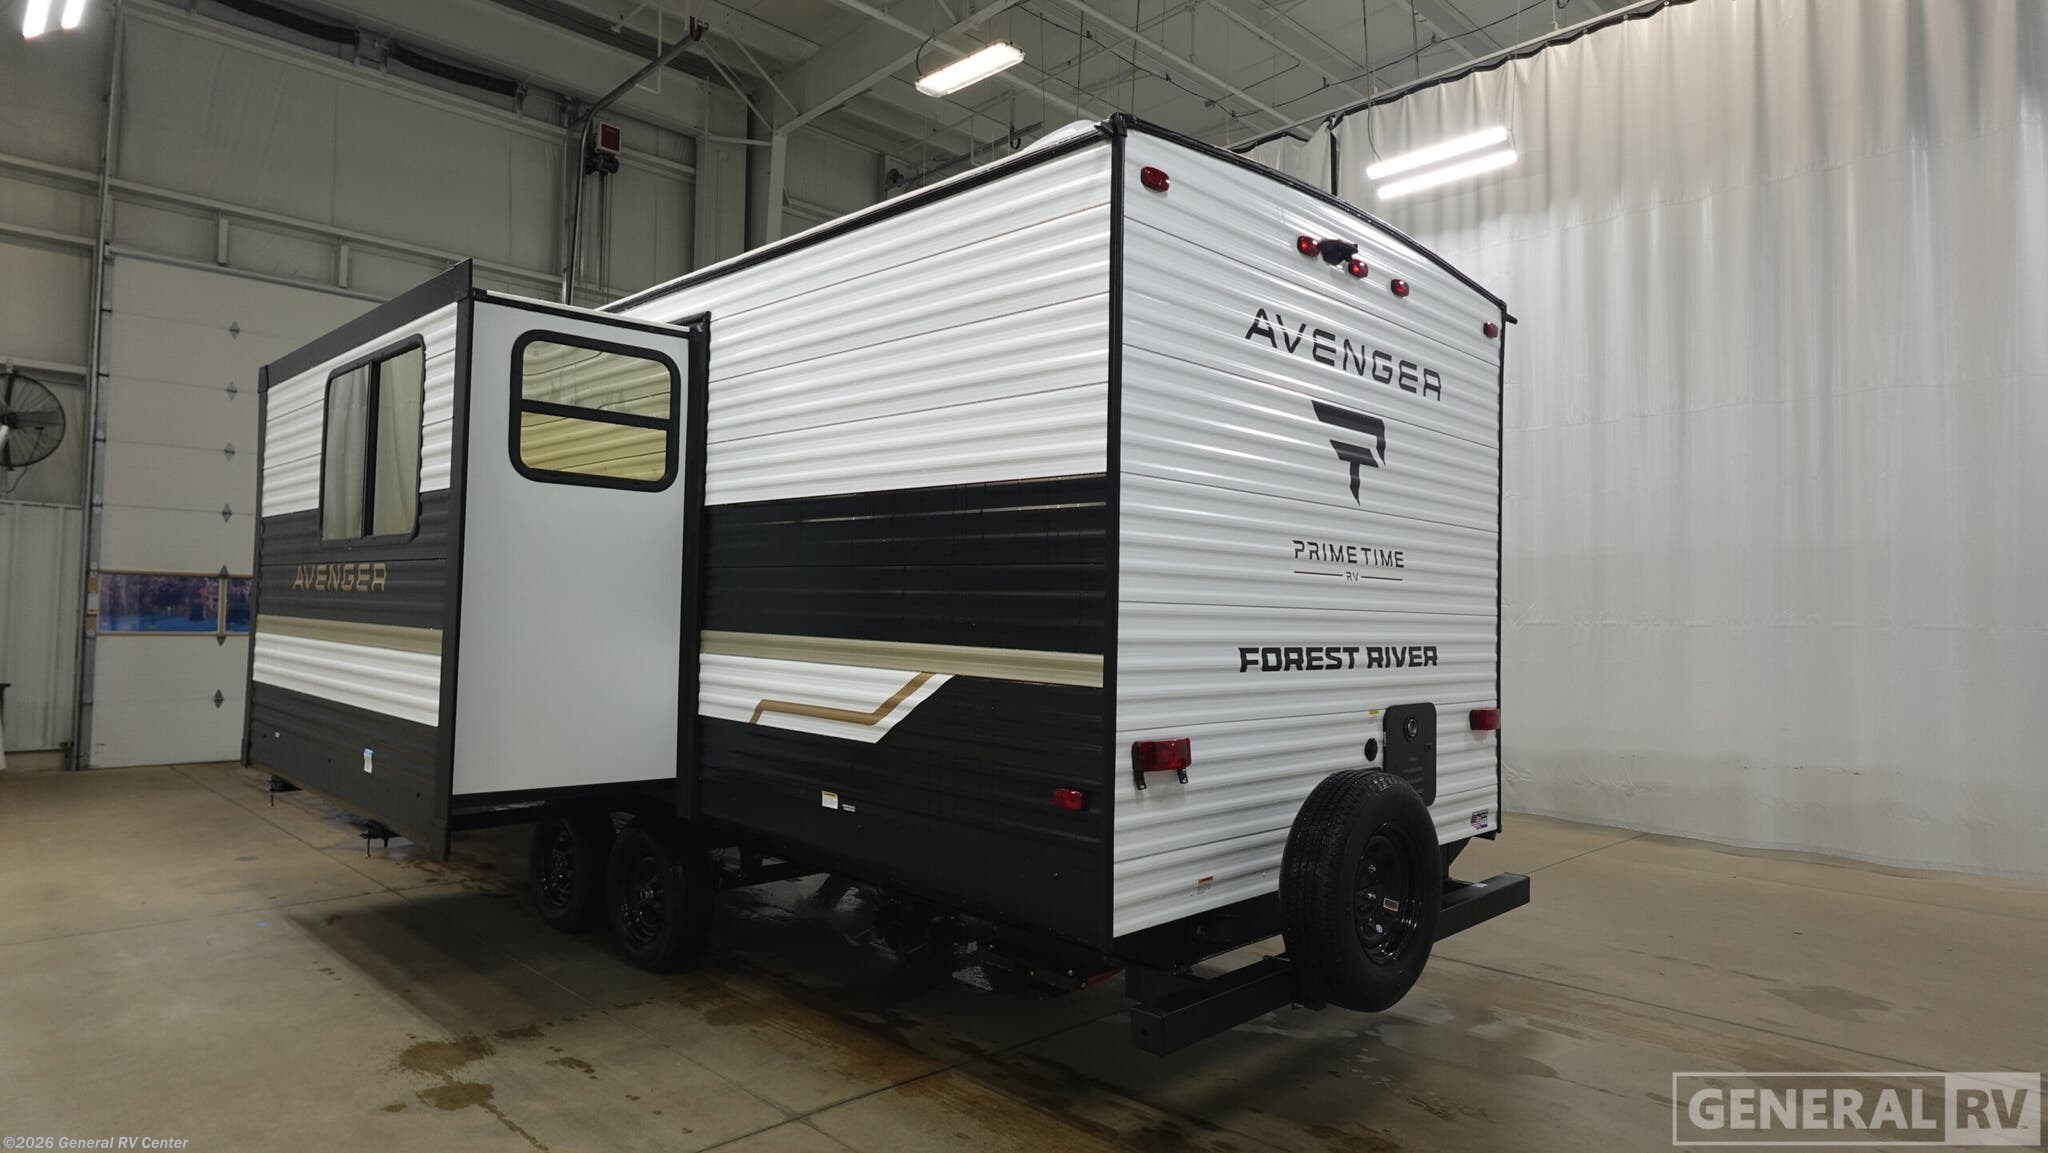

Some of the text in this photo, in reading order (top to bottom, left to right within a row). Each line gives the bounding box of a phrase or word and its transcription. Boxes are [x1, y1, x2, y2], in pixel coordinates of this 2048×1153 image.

[1245, 307, 1443, 402] AVENGER
[293, 561, 389, 593] AVENGER
[1345, 571, 1360, 582] RV
[1238, 645, 1439, 673] FOREST RIVER
